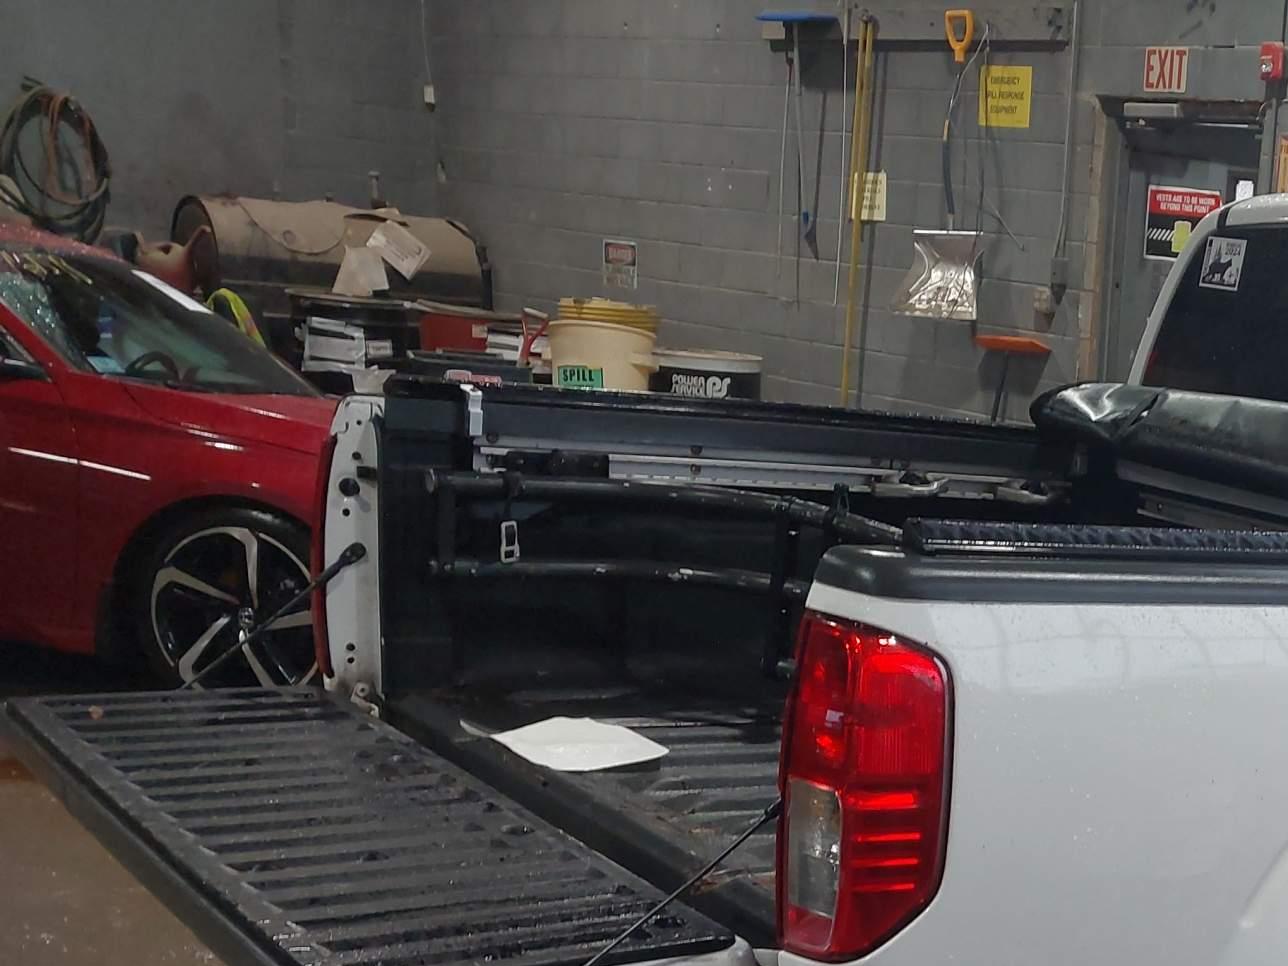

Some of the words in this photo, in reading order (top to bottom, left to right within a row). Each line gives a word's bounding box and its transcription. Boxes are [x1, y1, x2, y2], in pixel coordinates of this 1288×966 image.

[1145, 49, 1187, 90] EXIT
[1156, 193, 1172, 202] VESTS
[562, 368, 595, 383] SPILL
[672, 374, 705, 386] POWER
